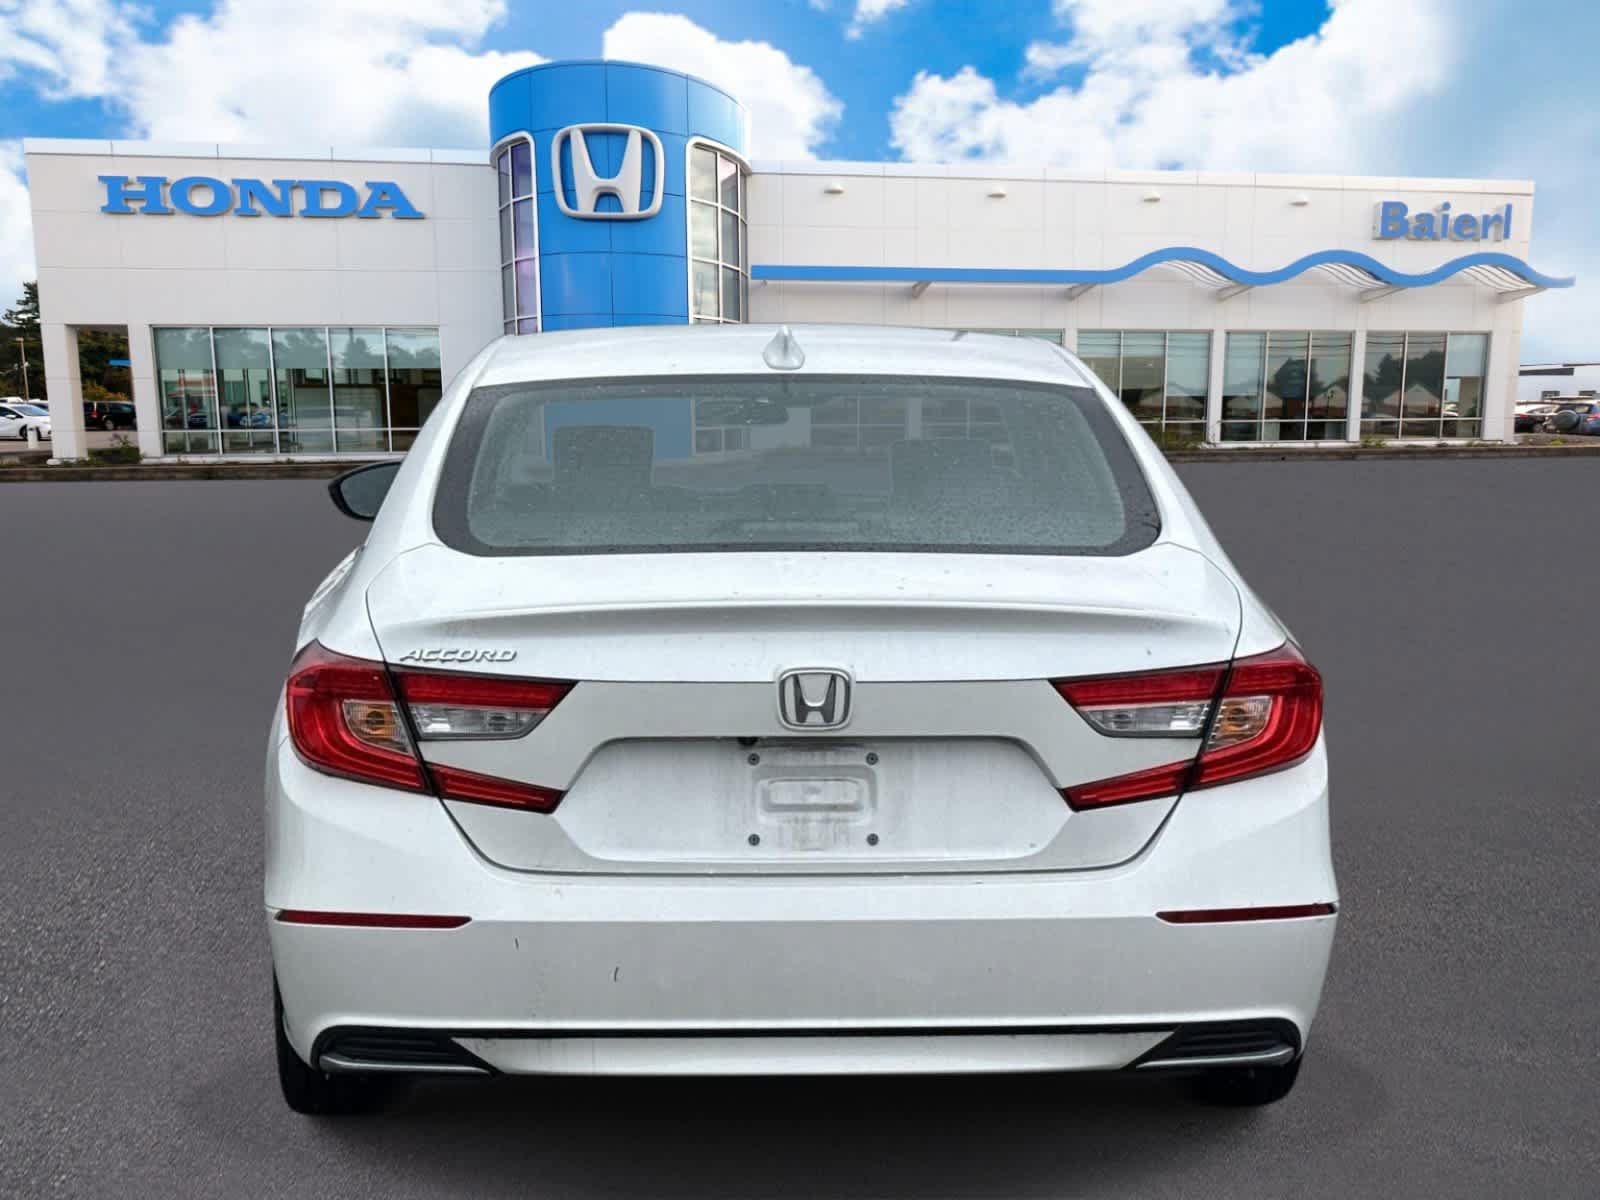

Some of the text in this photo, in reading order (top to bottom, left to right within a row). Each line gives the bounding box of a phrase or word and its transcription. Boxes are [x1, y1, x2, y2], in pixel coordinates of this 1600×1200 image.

[97, 175, 425, 219] HONDA
[1378, 200, 1513, 240] Baierl
[399, 648, 518, 663] ACCORD
